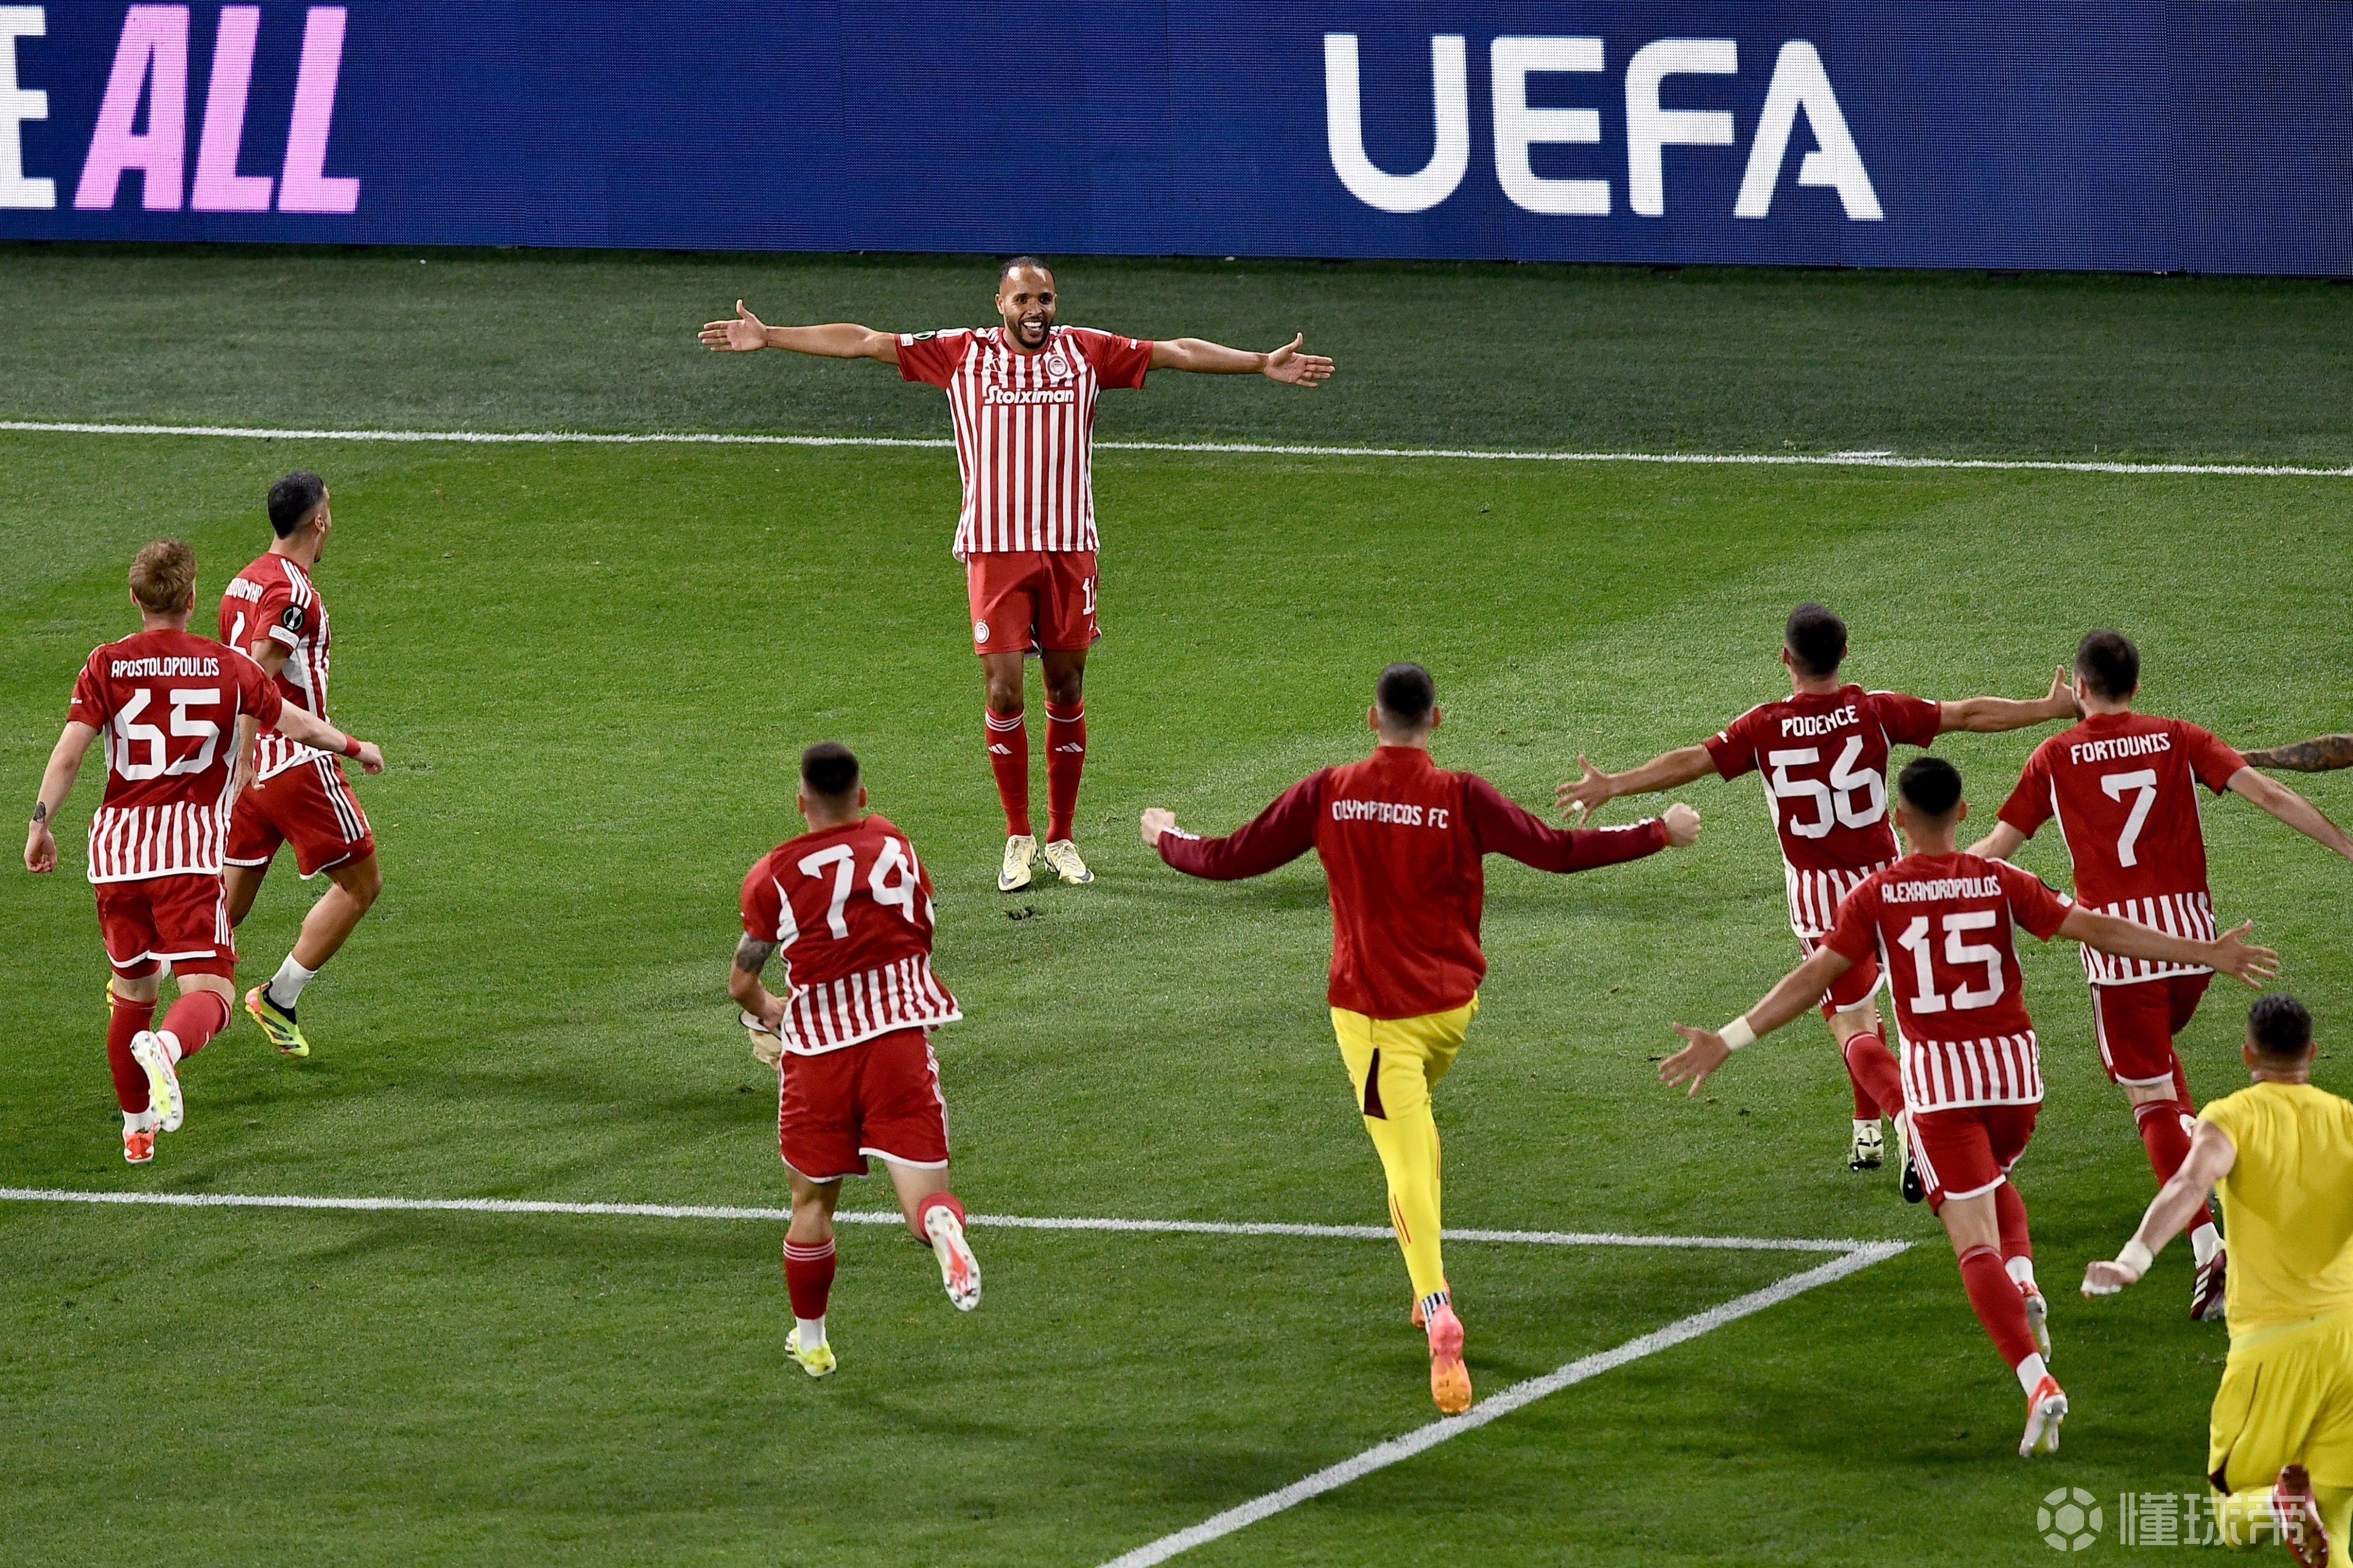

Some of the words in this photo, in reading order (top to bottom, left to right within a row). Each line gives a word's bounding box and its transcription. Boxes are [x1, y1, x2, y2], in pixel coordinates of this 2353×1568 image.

[73, 3, 360, 214] ALL
[1324, 32, 1884, 221] UEFA
[984, 385, 1074, 404] Stoiximan
[111, 656, 219, 678] APOSTOLOPOULOS
[114, 688, 221, 781] 65
[1781, 705, 1860, 738] PODENCE
[2070, 732, 2171, 765] FORTOUNIS
[1332, 799, 1423, 826] OLYMPIACOS
[1428, 807, 1449, 829] FC
[1769, 735, 1886, 839] 56
[2100, 768, 2157, 868] 7
[797, 836, 915, 940] 74
[1881, 875, 2002, 903] ALEXANDROPOULOS
[1897, 910, 2005, 1014] 15
